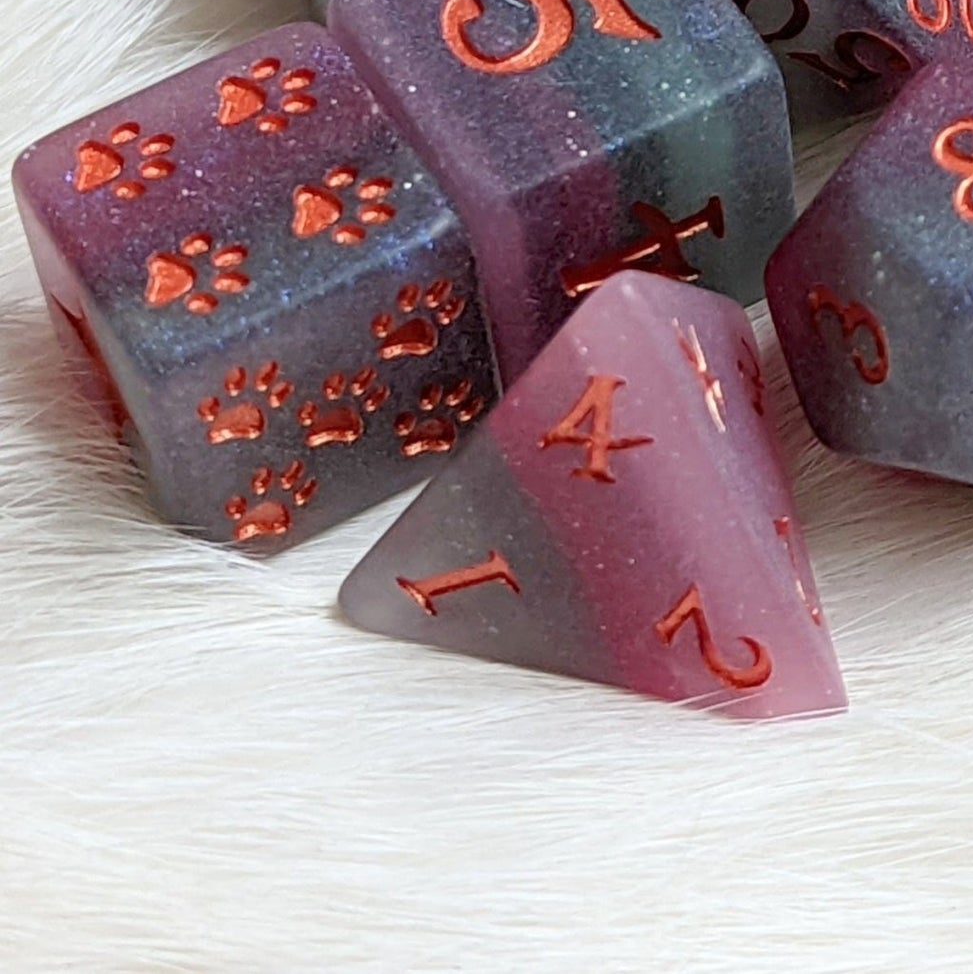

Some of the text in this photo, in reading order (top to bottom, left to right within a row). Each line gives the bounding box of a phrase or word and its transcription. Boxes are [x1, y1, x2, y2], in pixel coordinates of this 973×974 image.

[536, 373, 655, 485] 4
[395, 548, 522, 617] 1
[655, 582, 774, 692] 2
